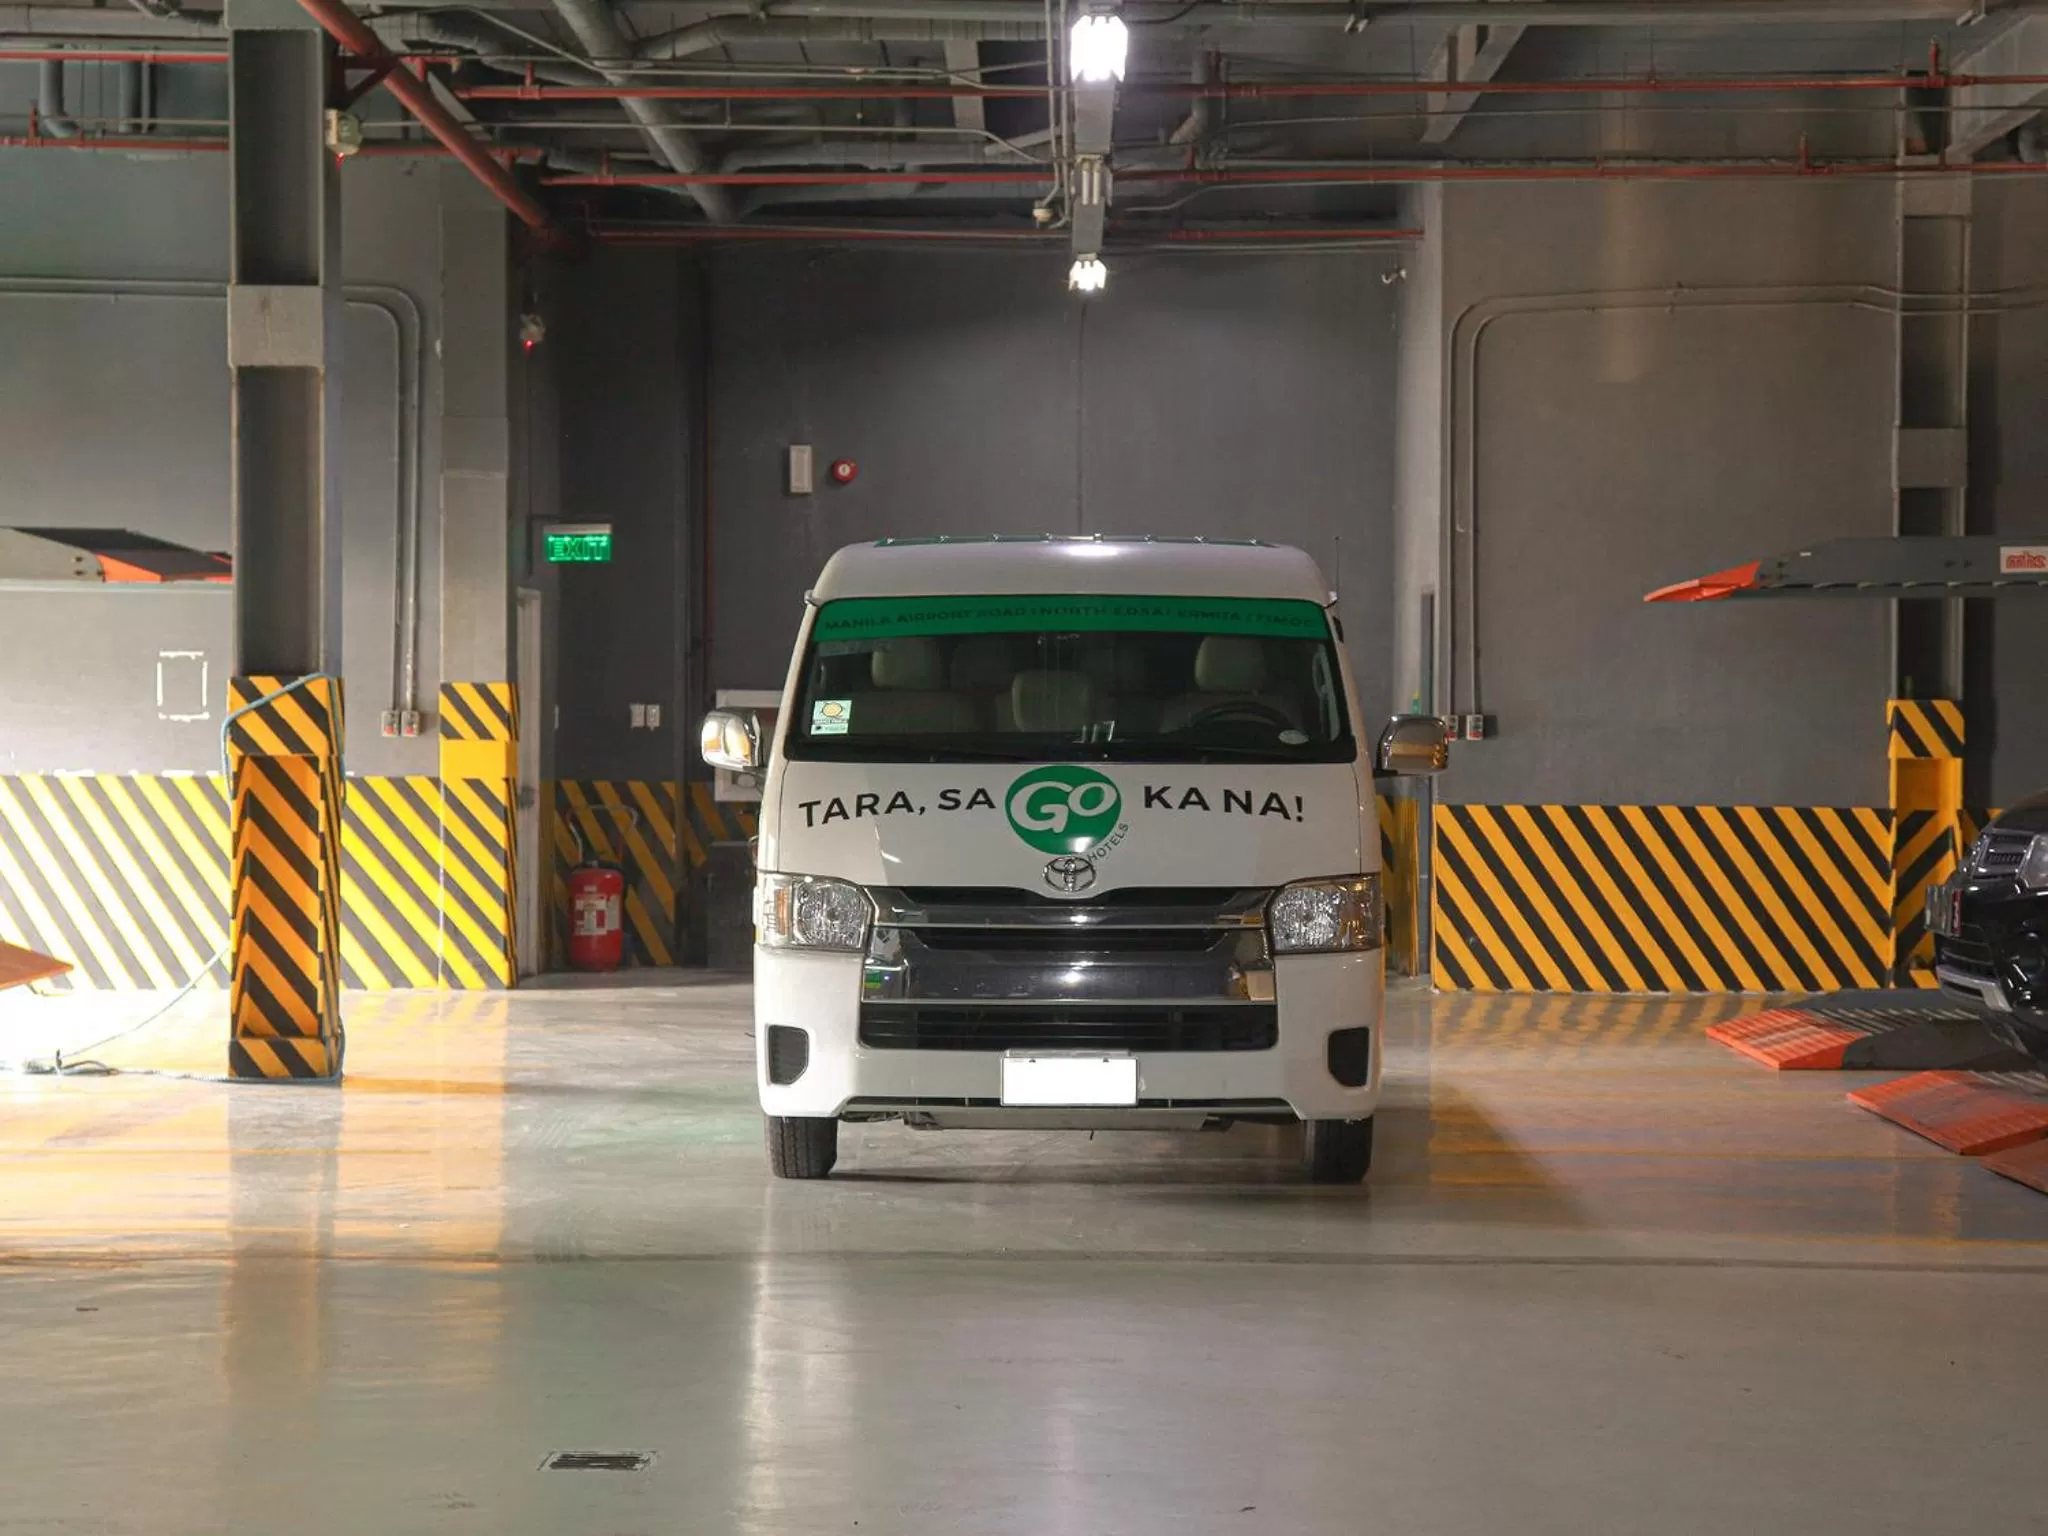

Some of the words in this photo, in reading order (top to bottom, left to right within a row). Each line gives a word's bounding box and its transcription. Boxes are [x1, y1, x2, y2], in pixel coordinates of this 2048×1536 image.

[548, 536, 609, 561] EXIT
[825, 615, 893, 629] MANILA
[896, 609, 973, 624] AIRPORT
[976, 607, 1025, 618] ROAD
[1038, 606, 1107, 617] NORTH
[799, 791, 925, 826] TARA,
[938, 788, 996, 810] SA
[1144, 786, 1210, 811] KA
[1224, 789, 1303, 822] NA!
[1087, 822, 1129, 863] HOTELS
